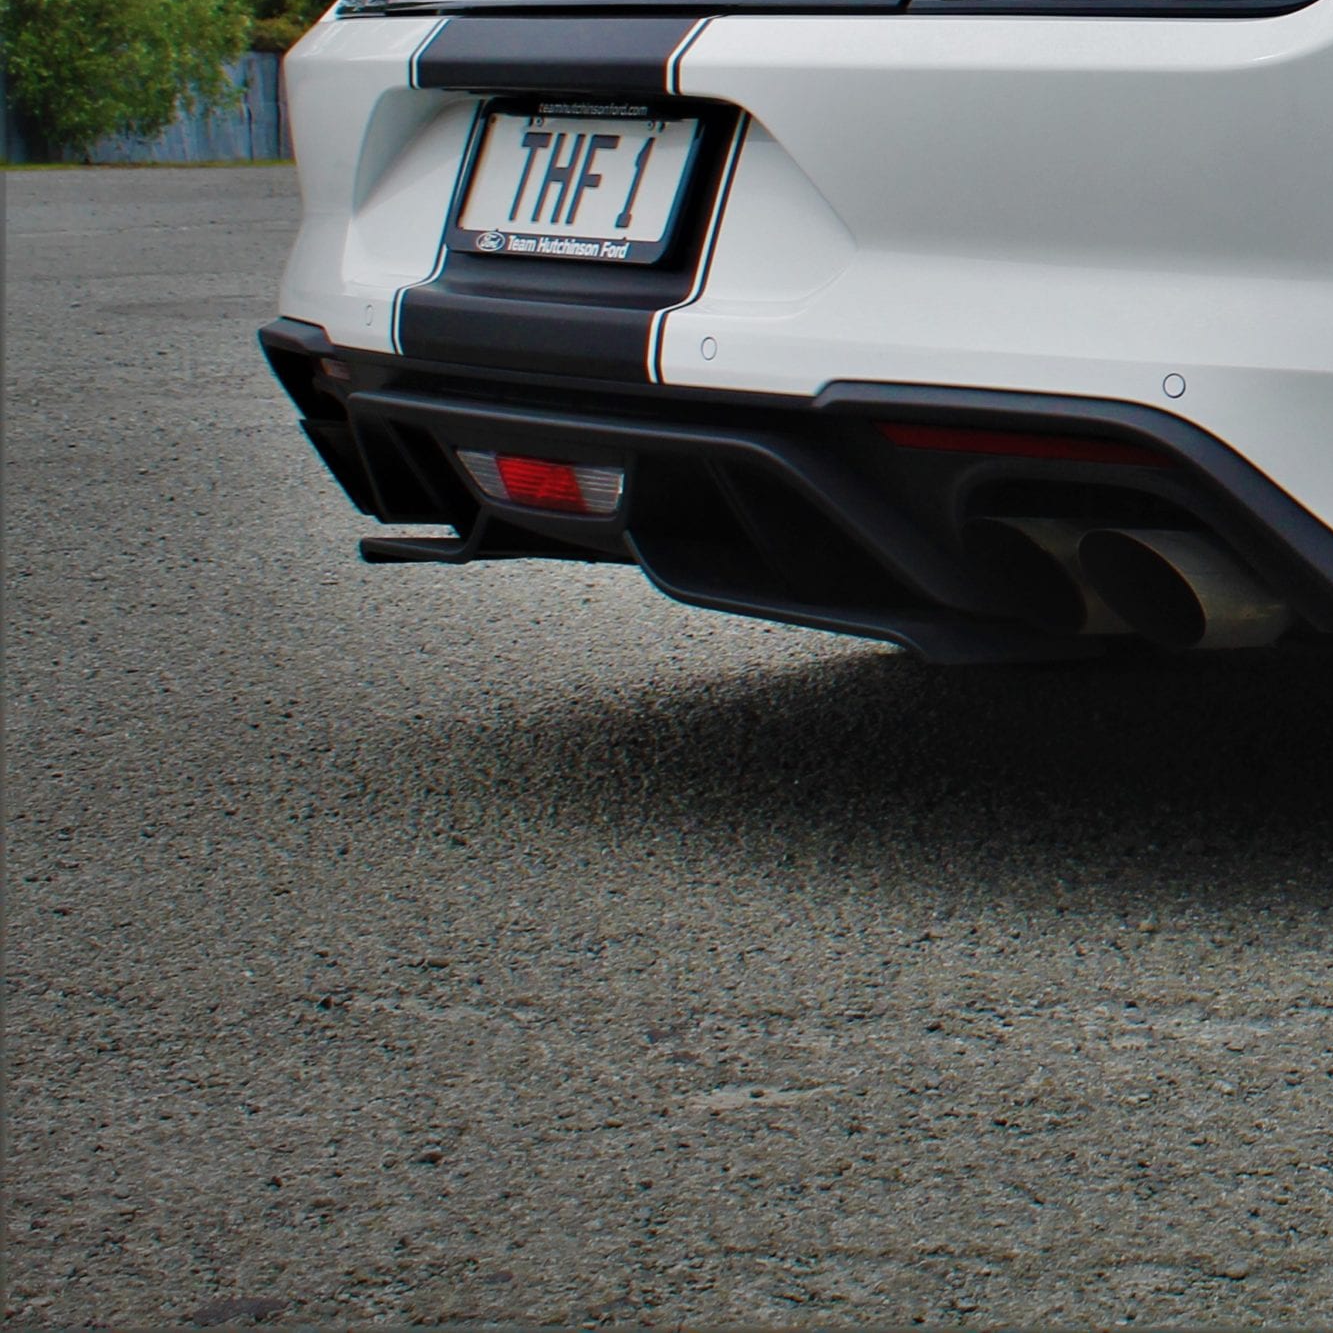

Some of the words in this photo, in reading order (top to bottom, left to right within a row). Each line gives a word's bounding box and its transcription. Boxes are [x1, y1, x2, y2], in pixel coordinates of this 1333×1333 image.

[509, 132, 620, 224] THF
[507, 234, 537, 252] Team
[536, 237, 599, 257] Hutchinson
[599, 241, 629, 259] Ford
